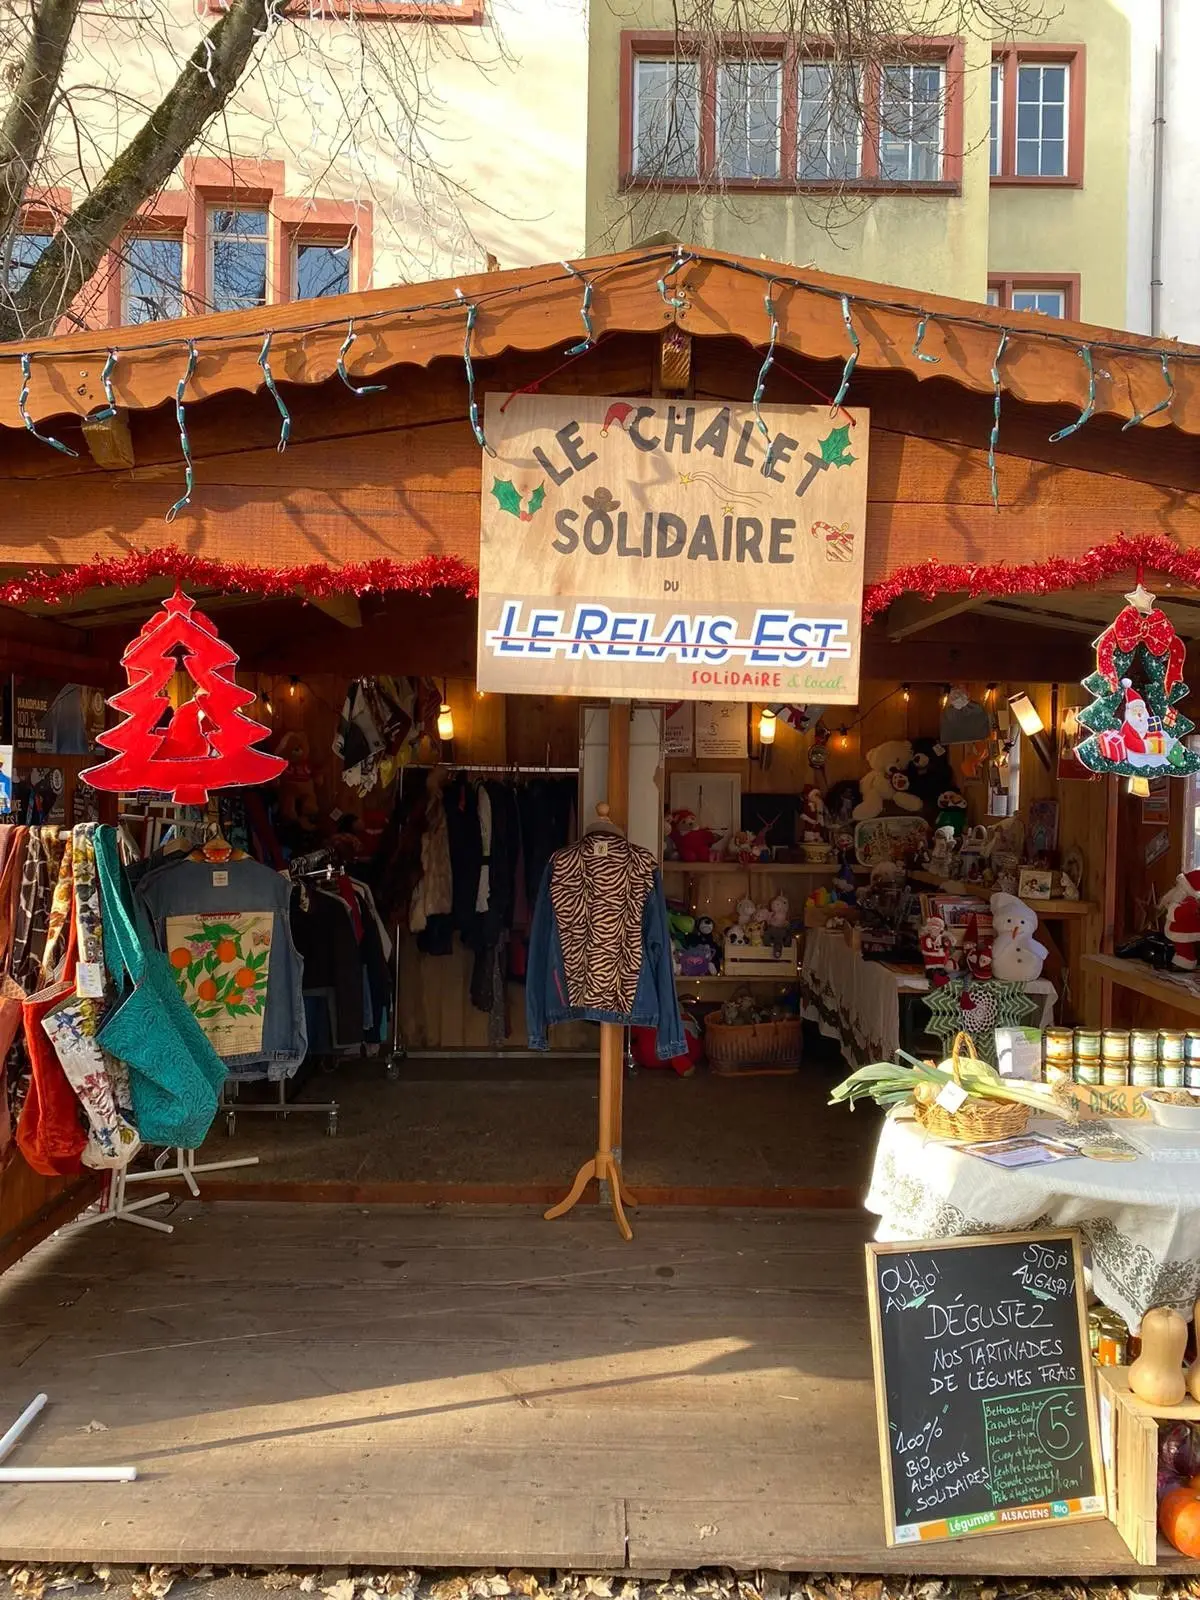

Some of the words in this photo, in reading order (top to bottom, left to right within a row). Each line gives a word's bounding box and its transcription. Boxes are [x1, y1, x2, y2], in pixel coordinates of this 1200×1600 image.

[533, 420, 599, 486] LE
[628, 405, 832, 497] CHALET
[551, 508, 796, 564] SOLIDAIRE
[663, 579, 679, 592] DU
[499, 605, 559, 653] LE
[571, 608, 732, 660] RELAIS
[750, 613, 843, 662] EST
[1023, 1244, 1068, 1270] STOP
[885, 1294, 907, 1314] AU
[924, 1293, 1053, 1340] DÉGUSTEZ
[932, 1348, 963, 1373] NOS
[929, 1374, 958, 1396] DE
[968, 1366, 1032, 1391] LÉGUMES
[896, 1416, 943, 1454] 100%
[949, 1512, 996, 1533] Légumes
[1001, 1508, 1050, 1522] ALSACIENS
[1053, 1504, 1068, 1514] BIO
